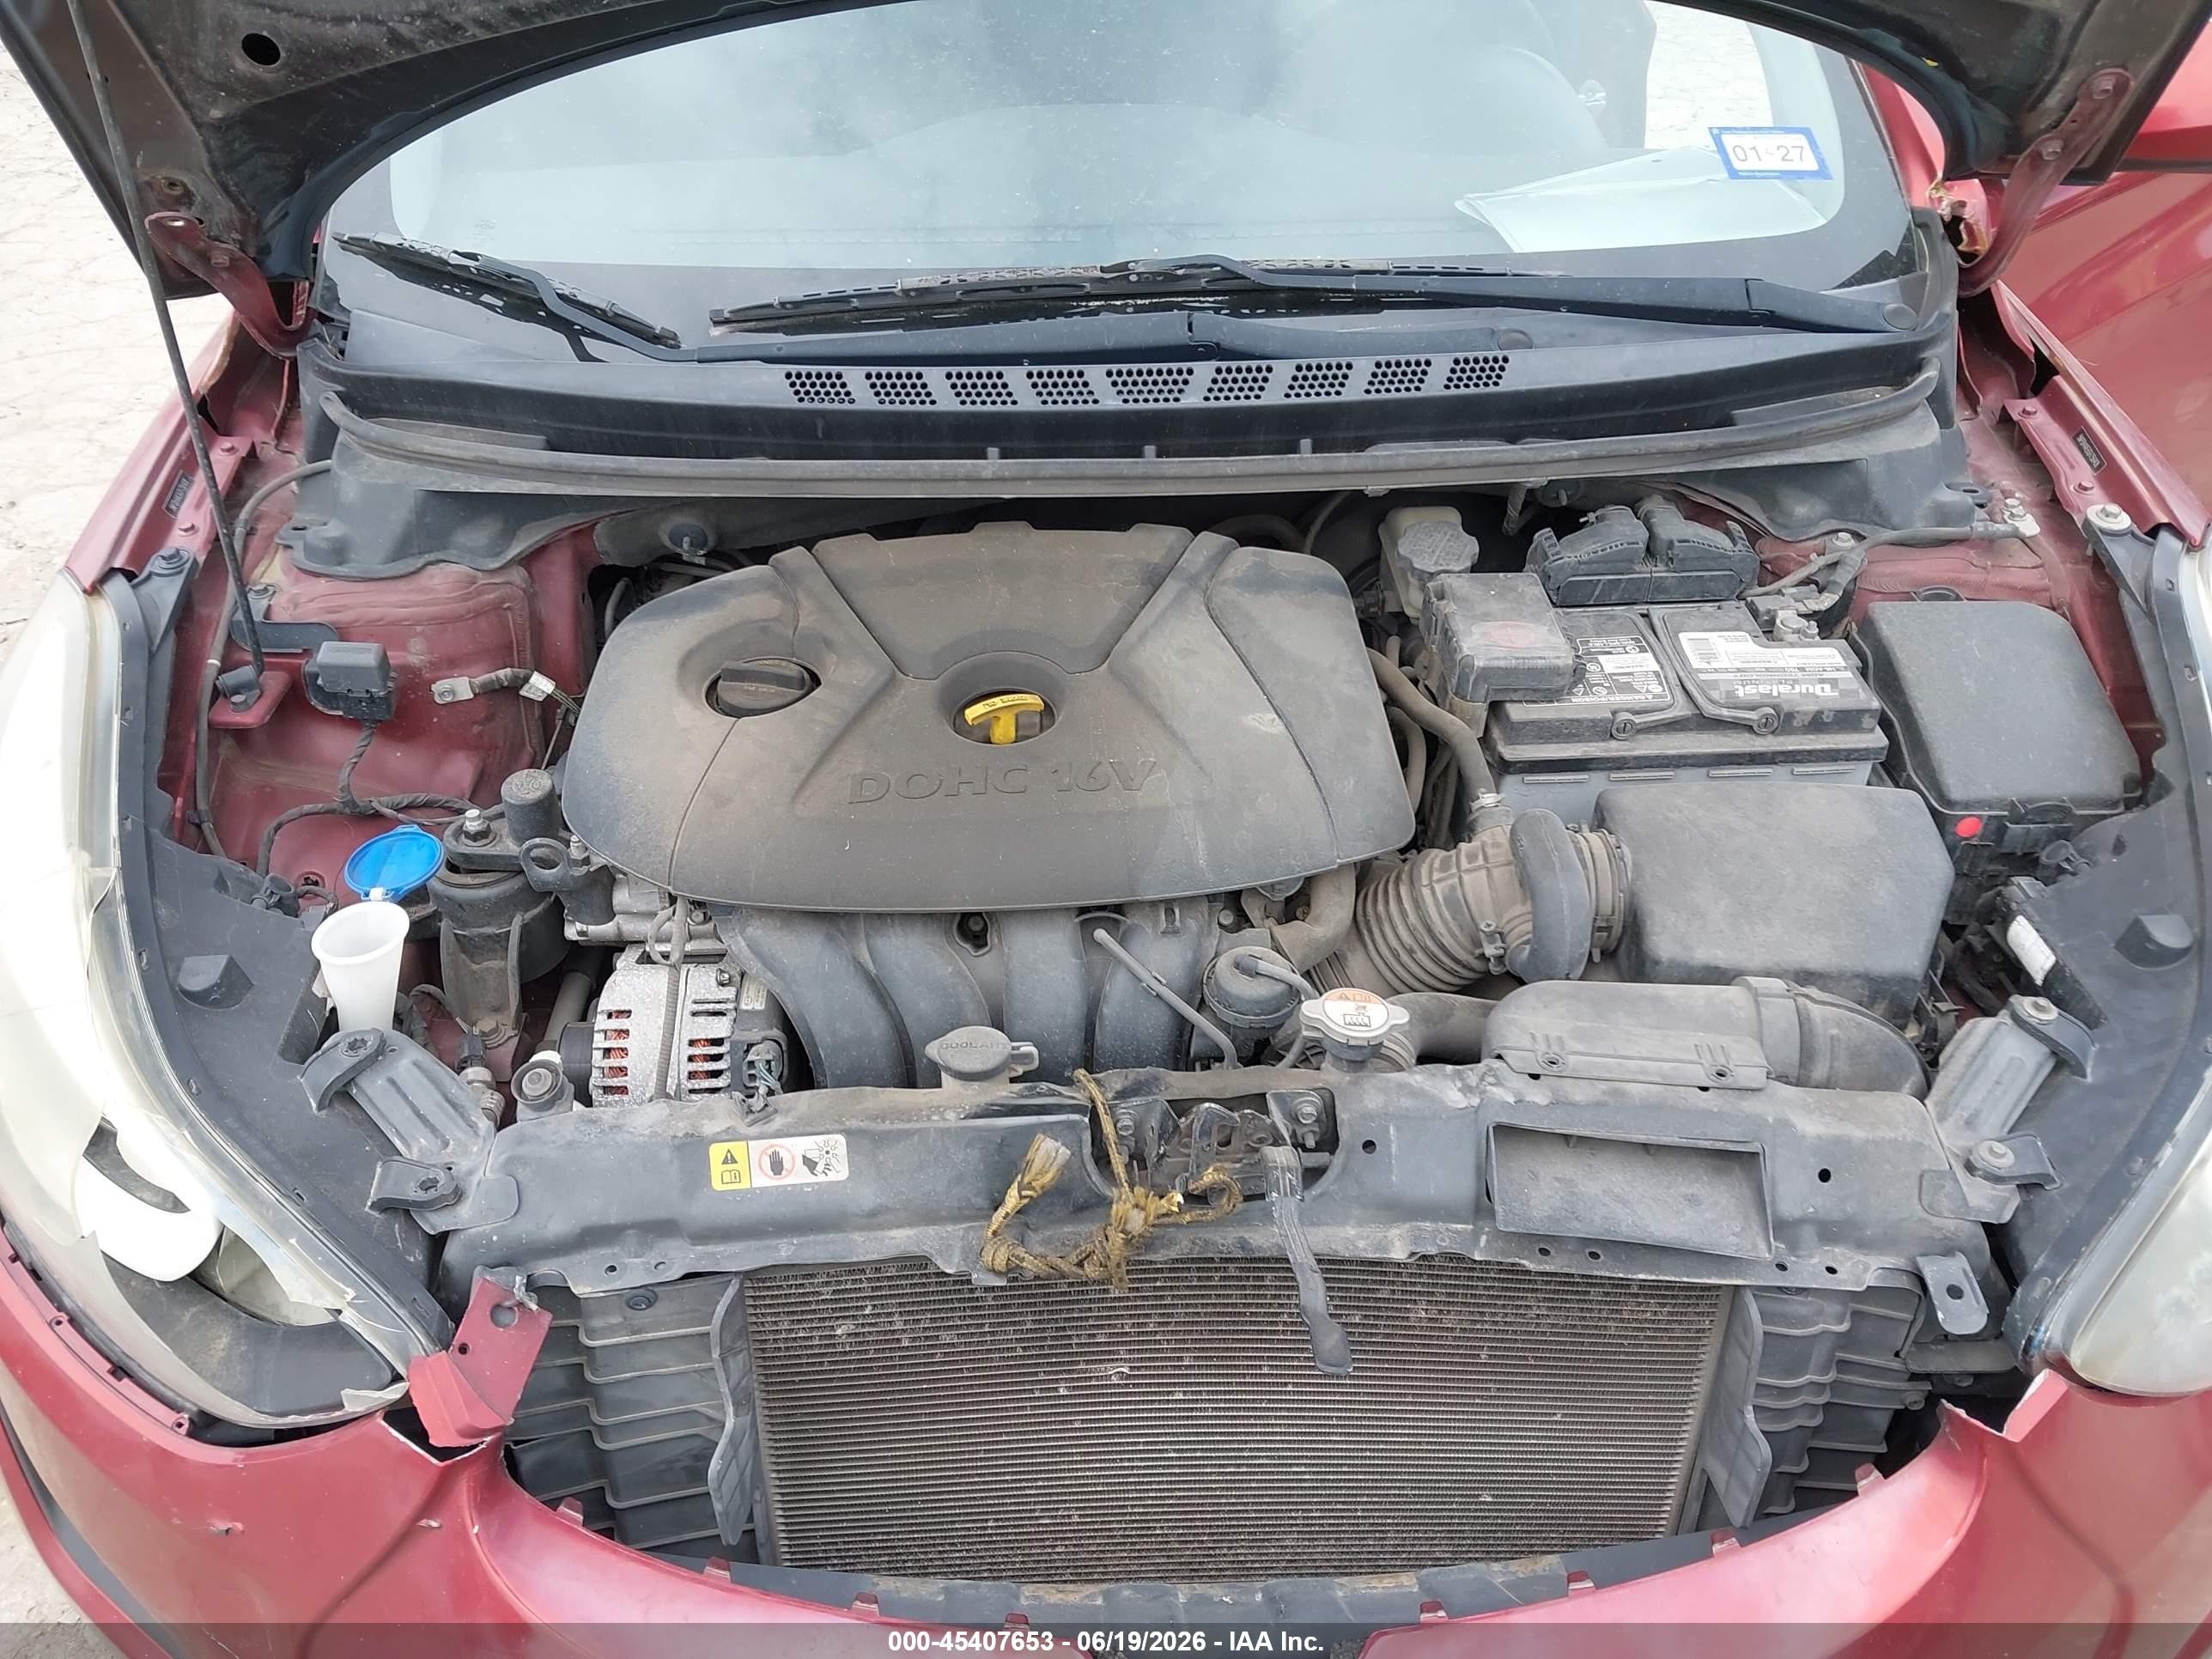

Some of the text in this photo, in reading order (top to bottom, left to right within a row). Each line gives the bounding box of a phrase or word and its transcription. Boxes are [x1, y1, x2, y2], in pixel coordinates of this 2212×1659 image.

[1734, 684, 1839, 697] Duralast
[848, 757, 1159, 805] DOHC 16V
